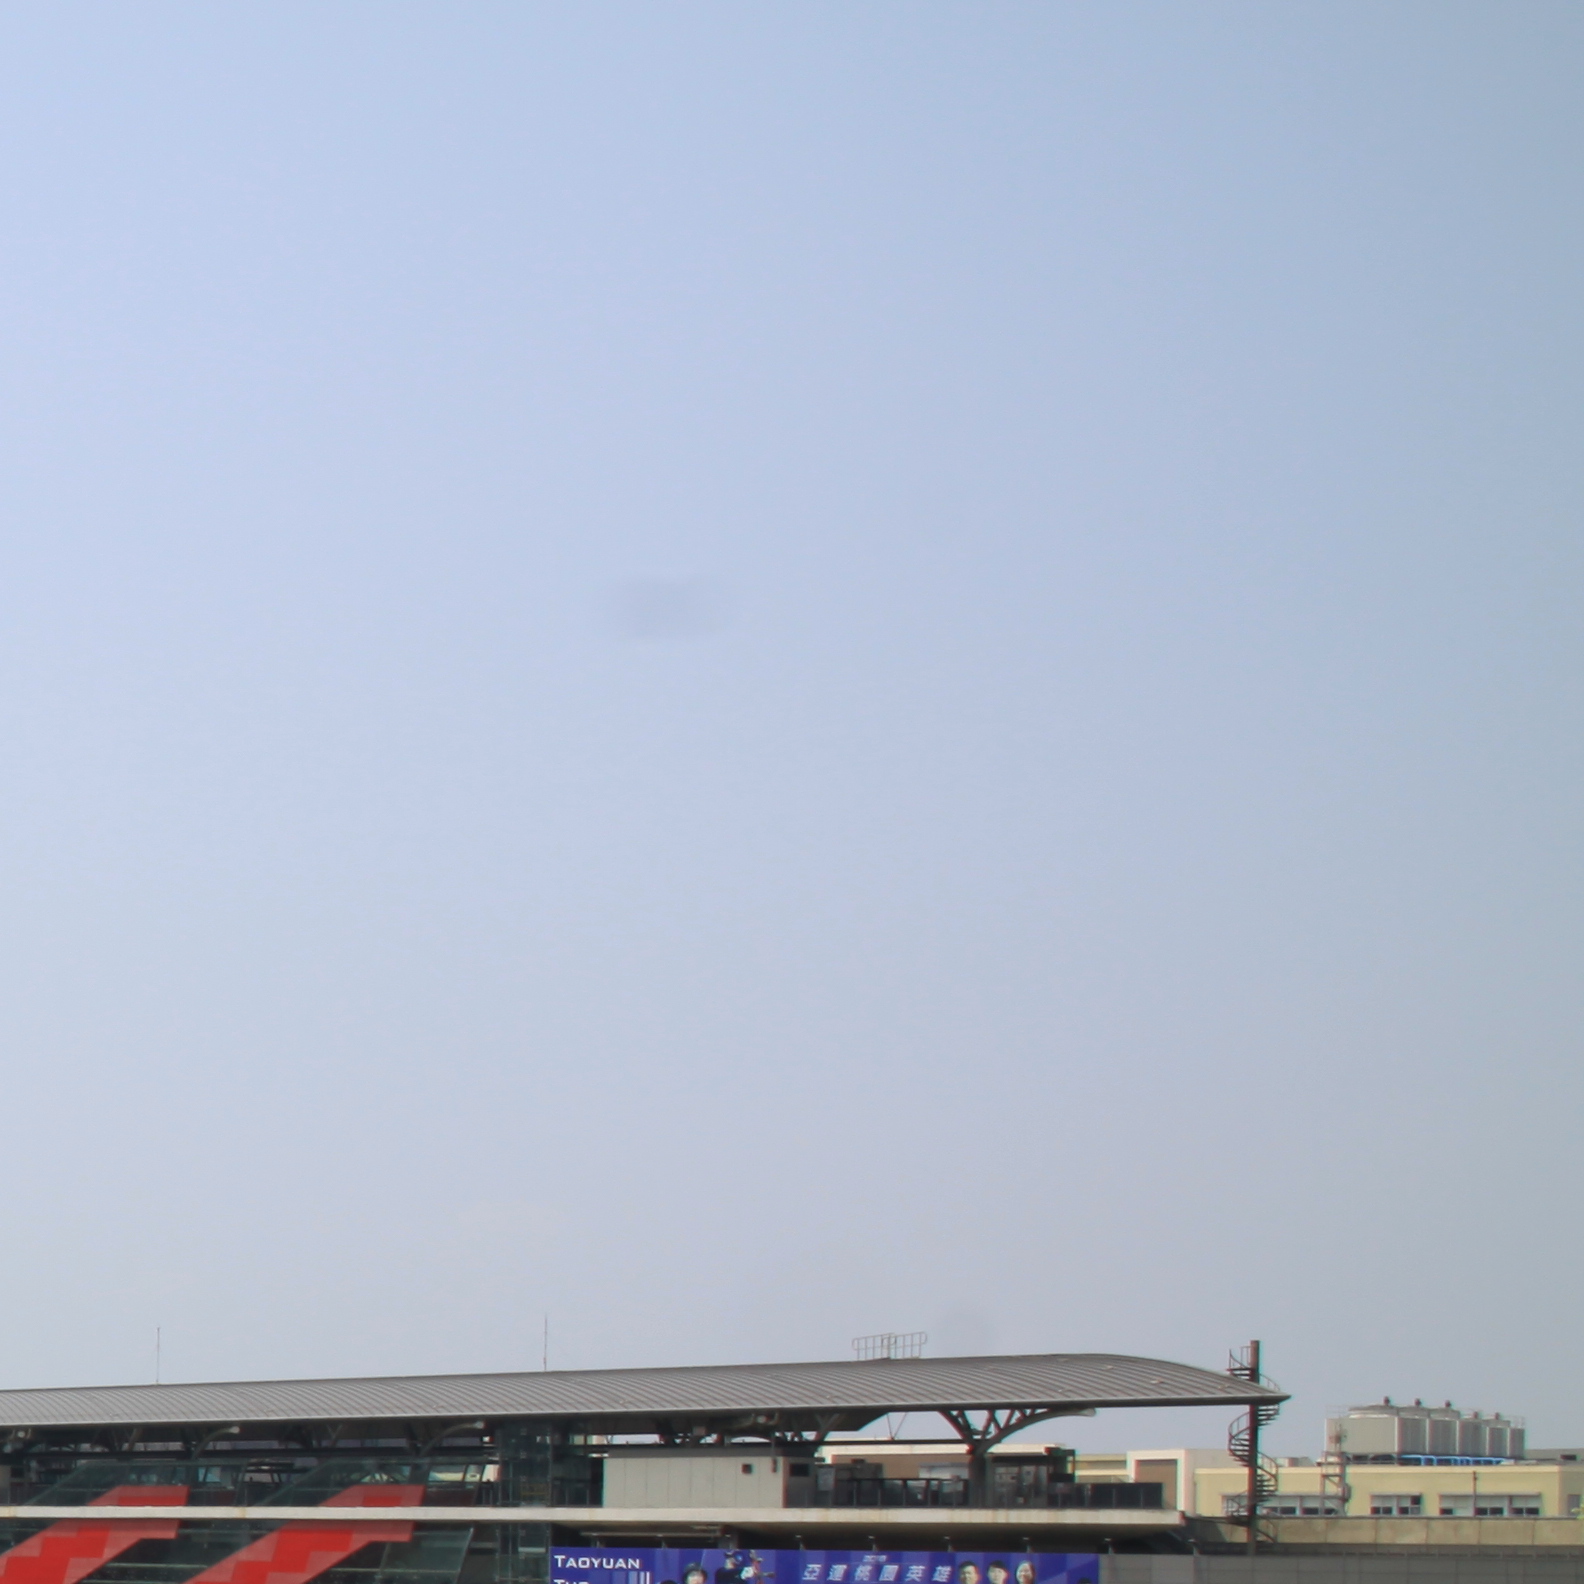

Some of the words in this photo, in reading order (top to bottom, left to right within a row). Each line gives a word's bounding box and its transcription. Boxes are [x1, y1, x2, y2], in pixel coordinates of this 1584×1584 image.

[554, 1555, 641, 1569] TAOYUAN
[801, 1563, 953, 1583] 亞運桃園英雄
